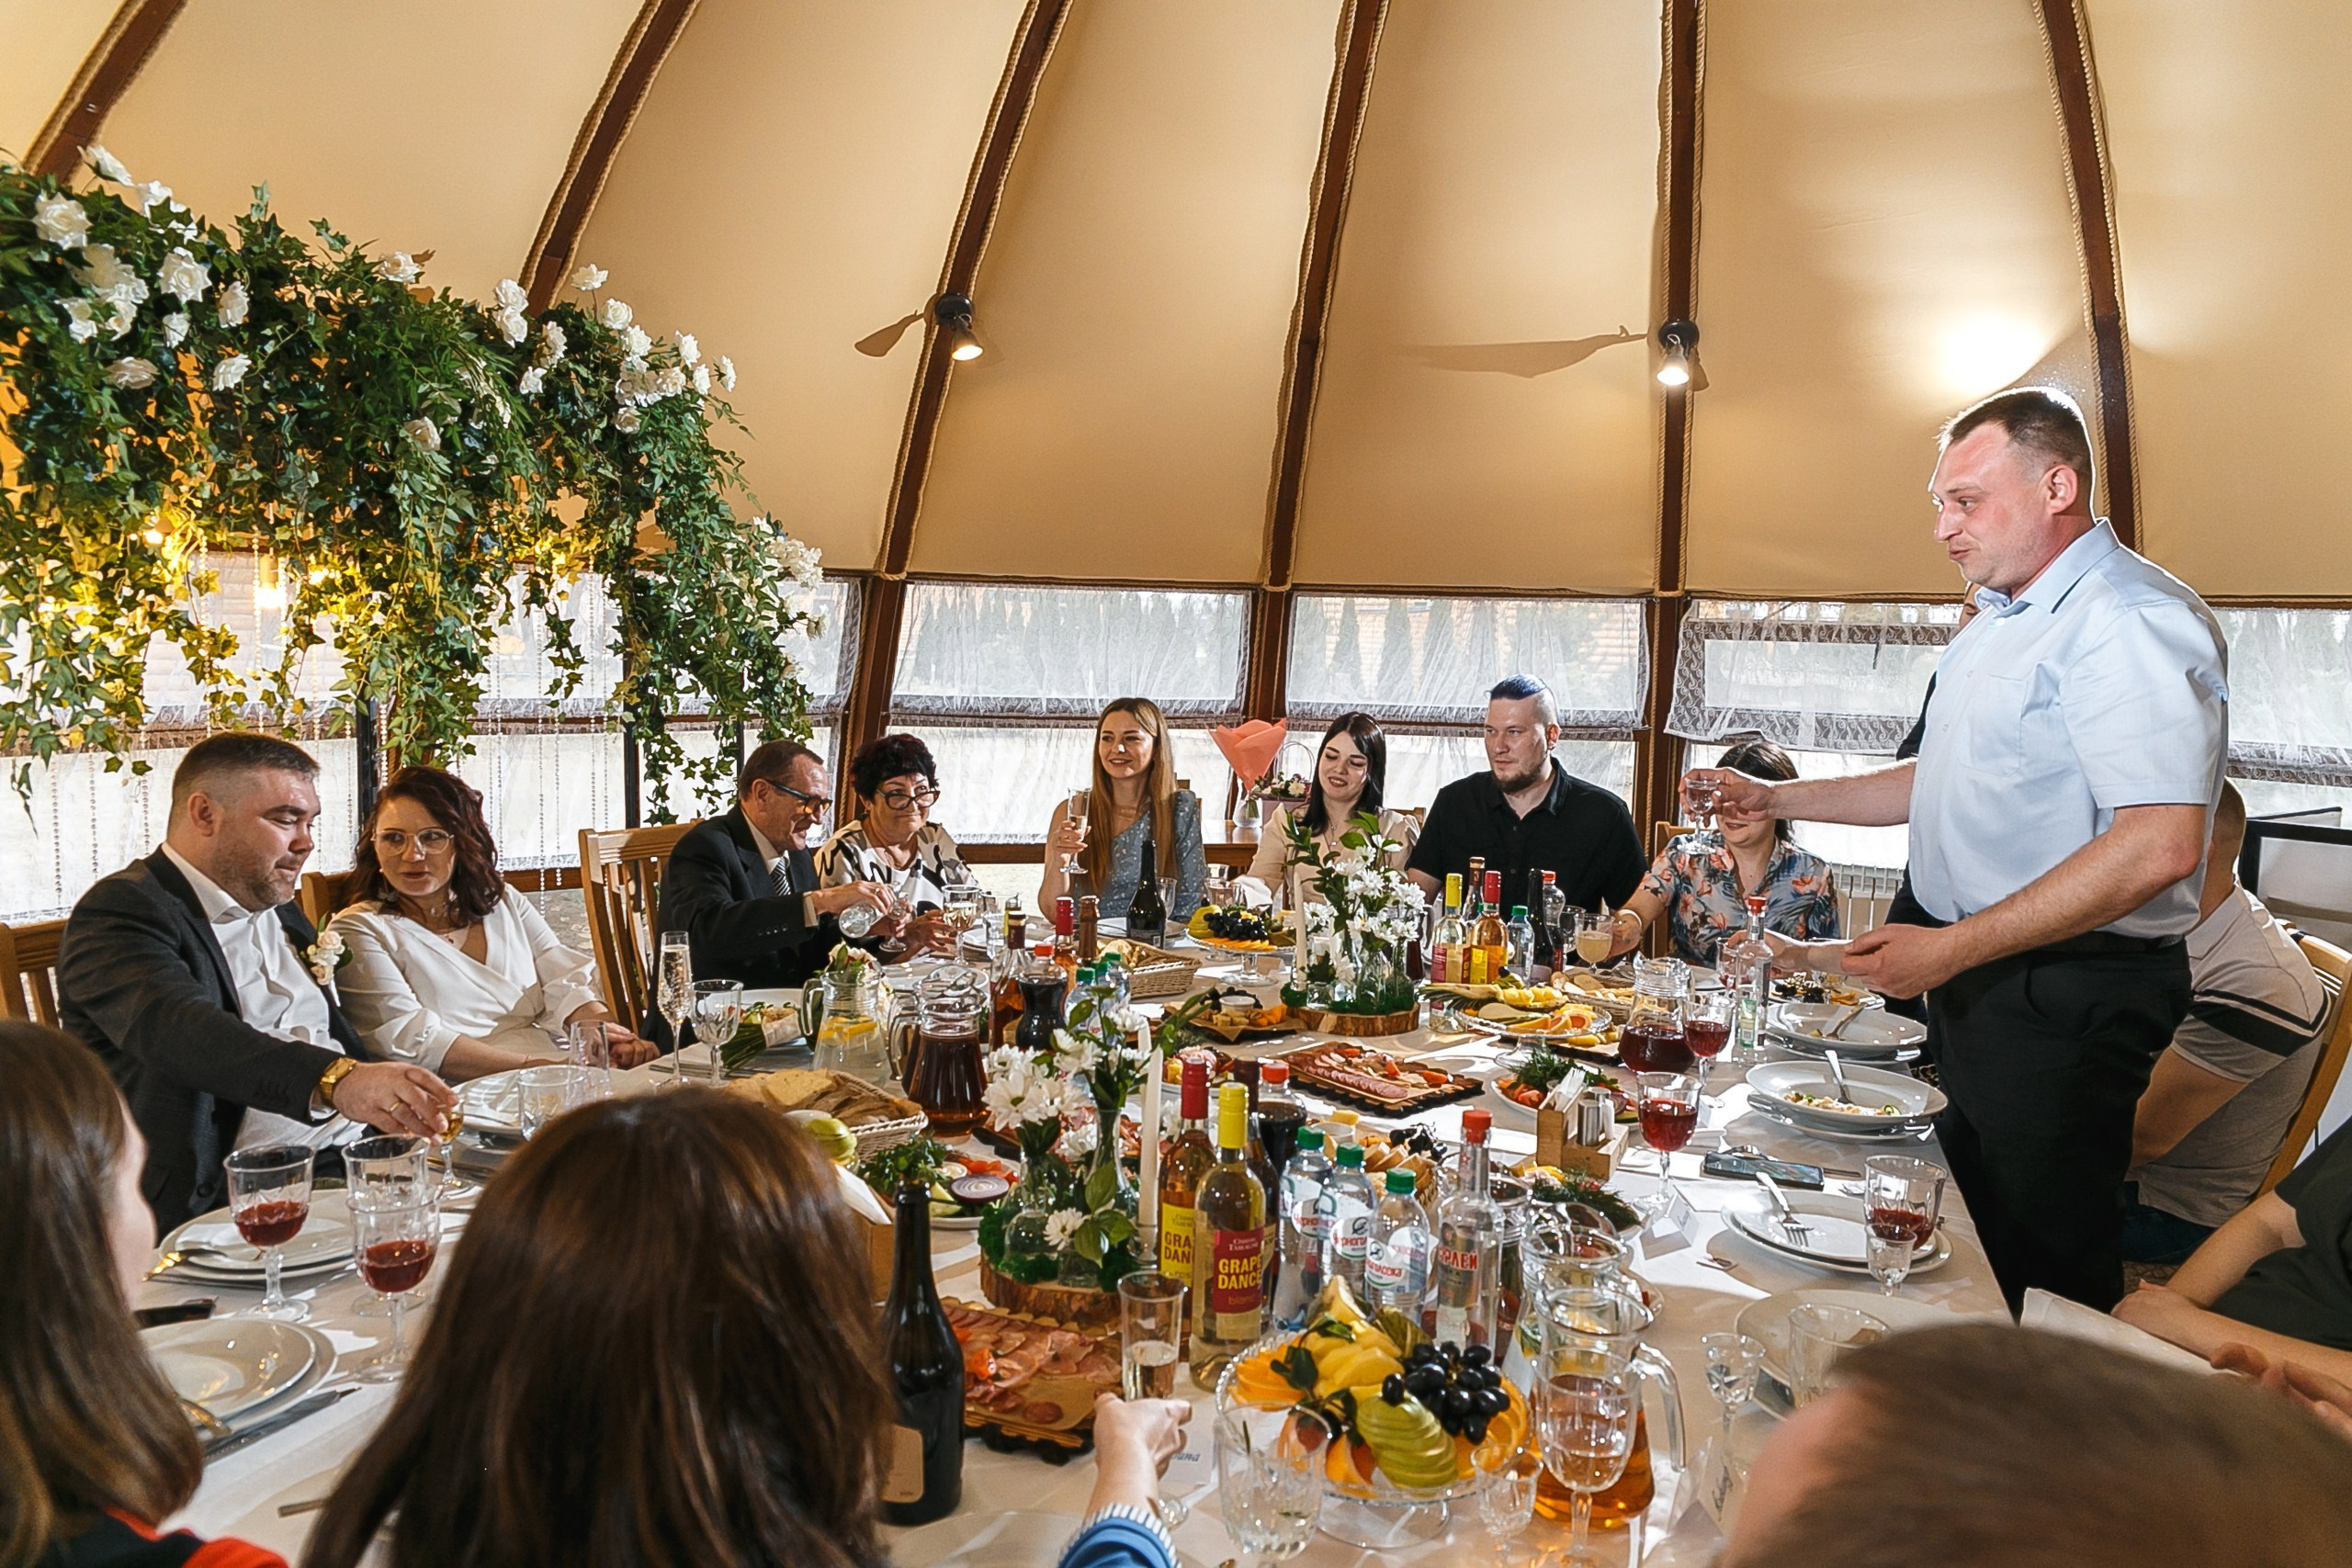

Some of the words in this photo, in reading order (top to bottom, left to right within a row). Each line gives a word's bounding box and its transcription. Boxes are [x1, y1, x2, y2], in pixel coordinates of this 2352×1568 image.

[1164, 1231, 1192, 1249] GRA
[1164, 1246, 1192, 1264] DAN
[1218, 1254, 1262, 1274] GRAPE
[1217, 1270, 1262, 1290] DANCE
